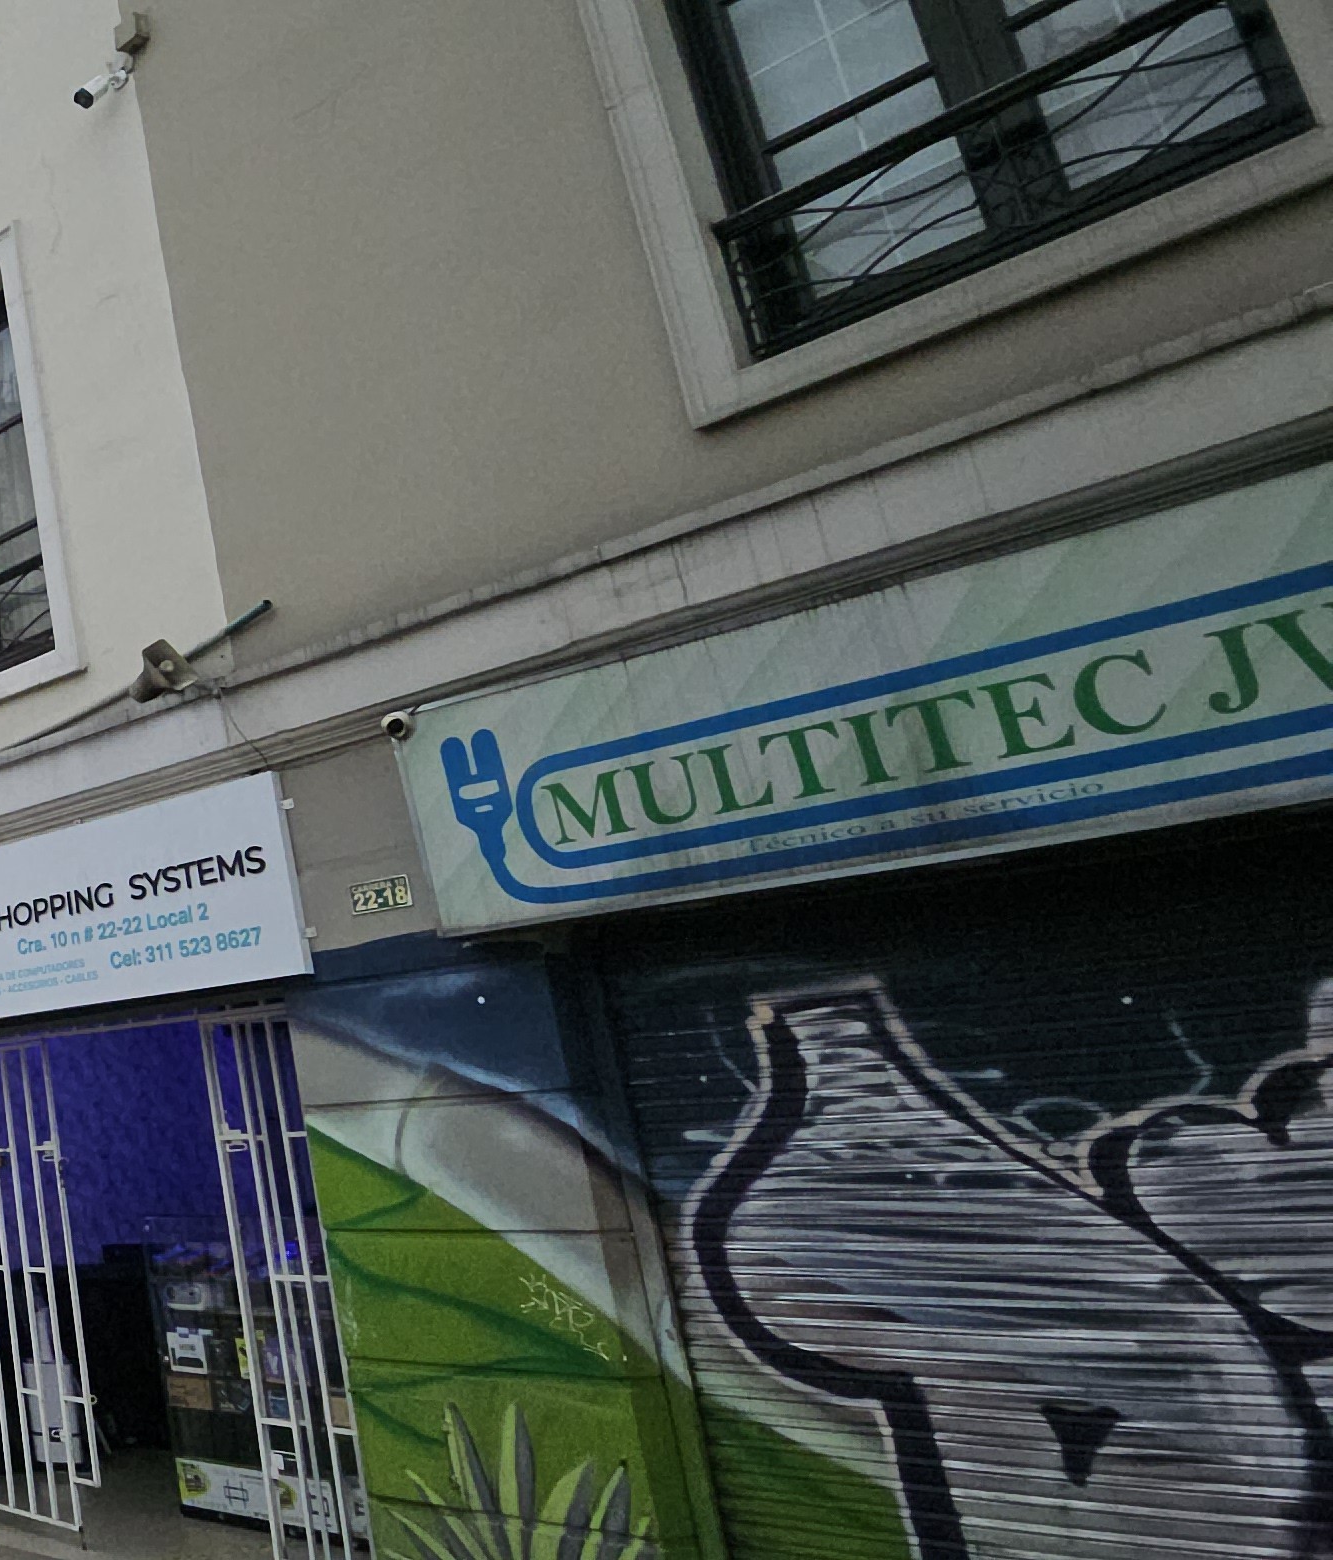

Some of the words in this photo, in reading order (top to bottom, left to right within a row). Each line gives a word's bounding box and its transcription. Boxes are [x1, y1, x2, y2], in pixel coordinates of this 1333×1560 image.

[541, 649, 1166, 846] MULTITEC
[880, 819, 895, 830] a
[912, 810, 947, 827] su
[963, 779, 1105, 816] servicio
[129, 846, 266, 900] SYSTEMS
[354, 886, 408, 911] 22-18
[17, 938, 47, 954] Cra.
[50, 931, 68, 949] 10
[71, 931, 81, 945] n
[97, 916, 143, 940] 22-22
[146, 905, 193, 931] Local
[198, 902, 209, 921] 2
[110, 949, 141, 969] Cel:
[145, 942, 173, 963] 311
[179, 935, 211, 958] 523
[216, 926, 262, 951] 8627
